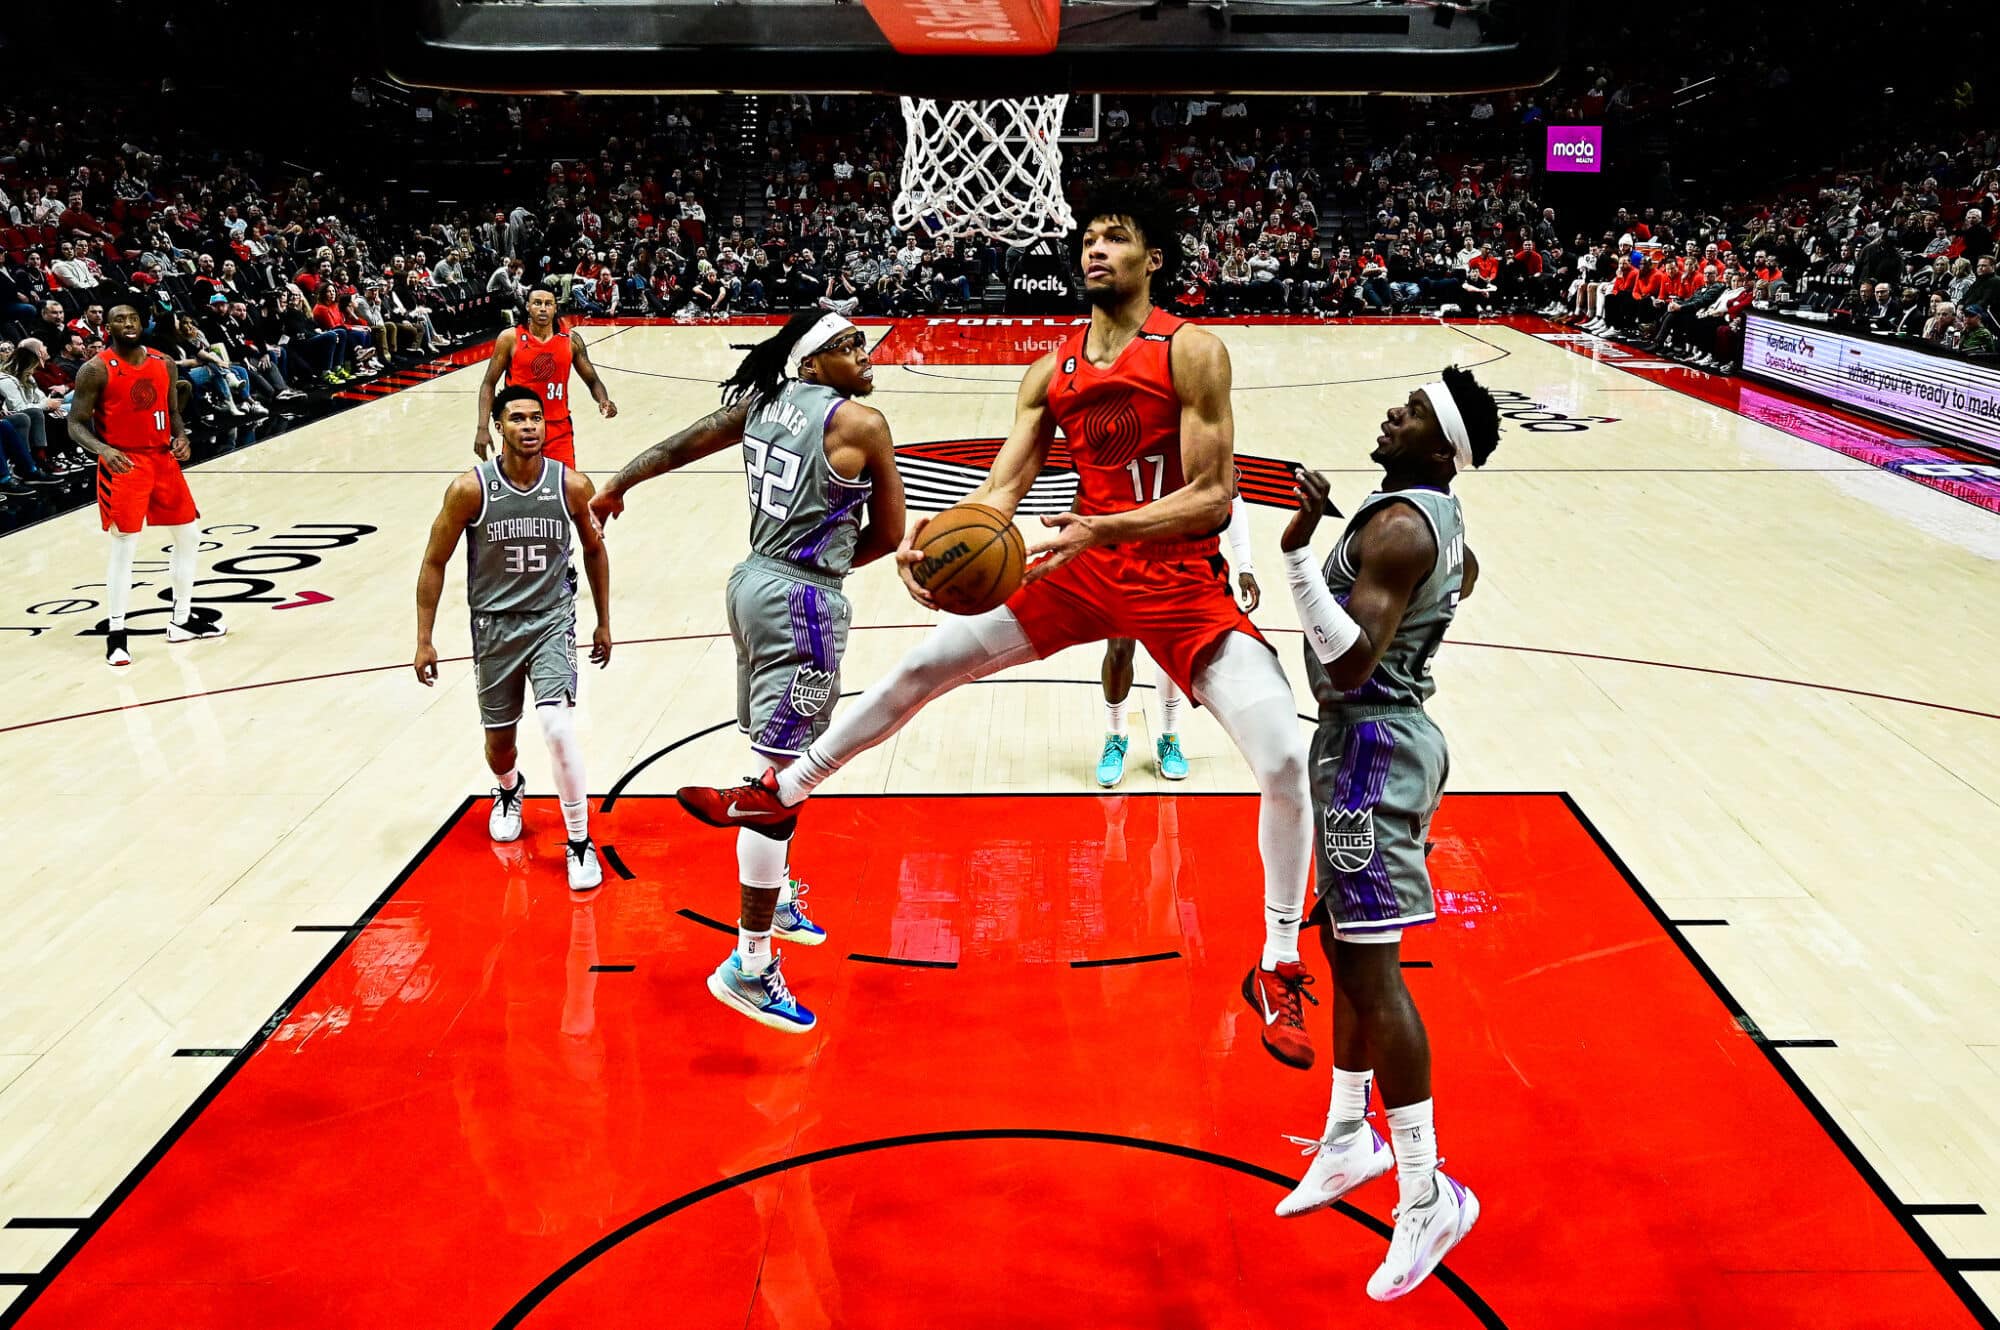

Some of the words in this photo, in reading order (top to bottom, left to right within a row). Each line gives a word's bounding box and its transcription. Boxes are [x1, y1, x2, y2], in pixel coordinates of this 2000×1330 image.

[1553, 139, 1594, 156] moda
[1013, 273, 1068, 297] ripcity
[926, 317, 1092, 326] PORTLA
[1766, 334, 1797, 354] KeyBank
[1065, 357, 1075, 373] 6
[546, 382, 563, 401] 34
[1847, 362, 1876, 387] when
[1878, 373, 1913, 396] you're
[1915, 382, 1949, 409] ready
[1952, 387, 1965, 410] to
[152, 410, 166, 431] 11
[760, 400, 808, 437] HOLMES
[490, 480, 500, 491] 6
[742, 433, 803, 521] 22
[1126, 454, 1165, 502] 17
[486, 517, 563, 542] SACRAMENTO
[503, 544, 548, 573] 35
[793, 684, 829, 700] KINGS
[1326, 834, 1373, 848] KINGS
